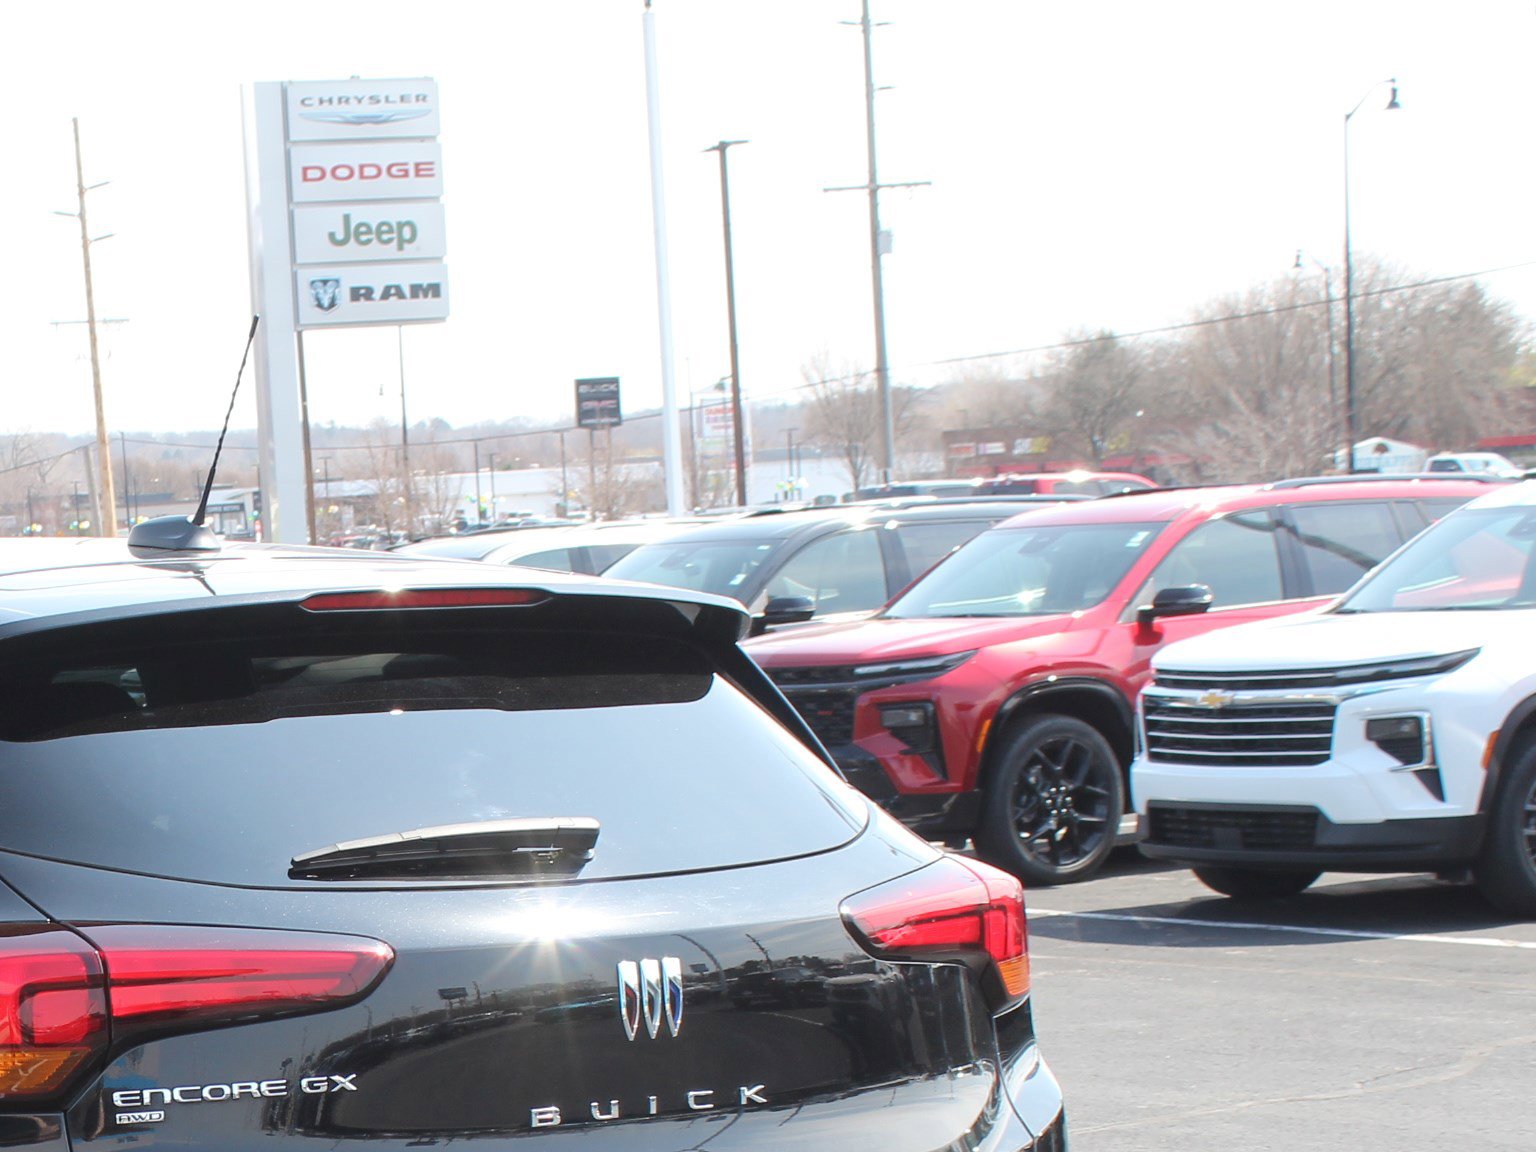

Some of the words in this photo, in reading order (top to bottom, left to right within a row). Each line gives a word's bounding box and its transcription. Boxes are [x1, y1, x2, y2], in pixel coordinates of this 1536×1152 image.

[299, 93, 430, 108] CHRYSLER
[301, 161, 437, 184] DODGE
[327, 213, 419, 252] Jeep
[349, 282, 443, 303] RAM
[111, 1079, 288, 1108] ENCORE
[300, 1073, 358, 1095] GX
[116, 1110, 164, 1124] AWD
[530, 1084, 768, 1128] BUICK
